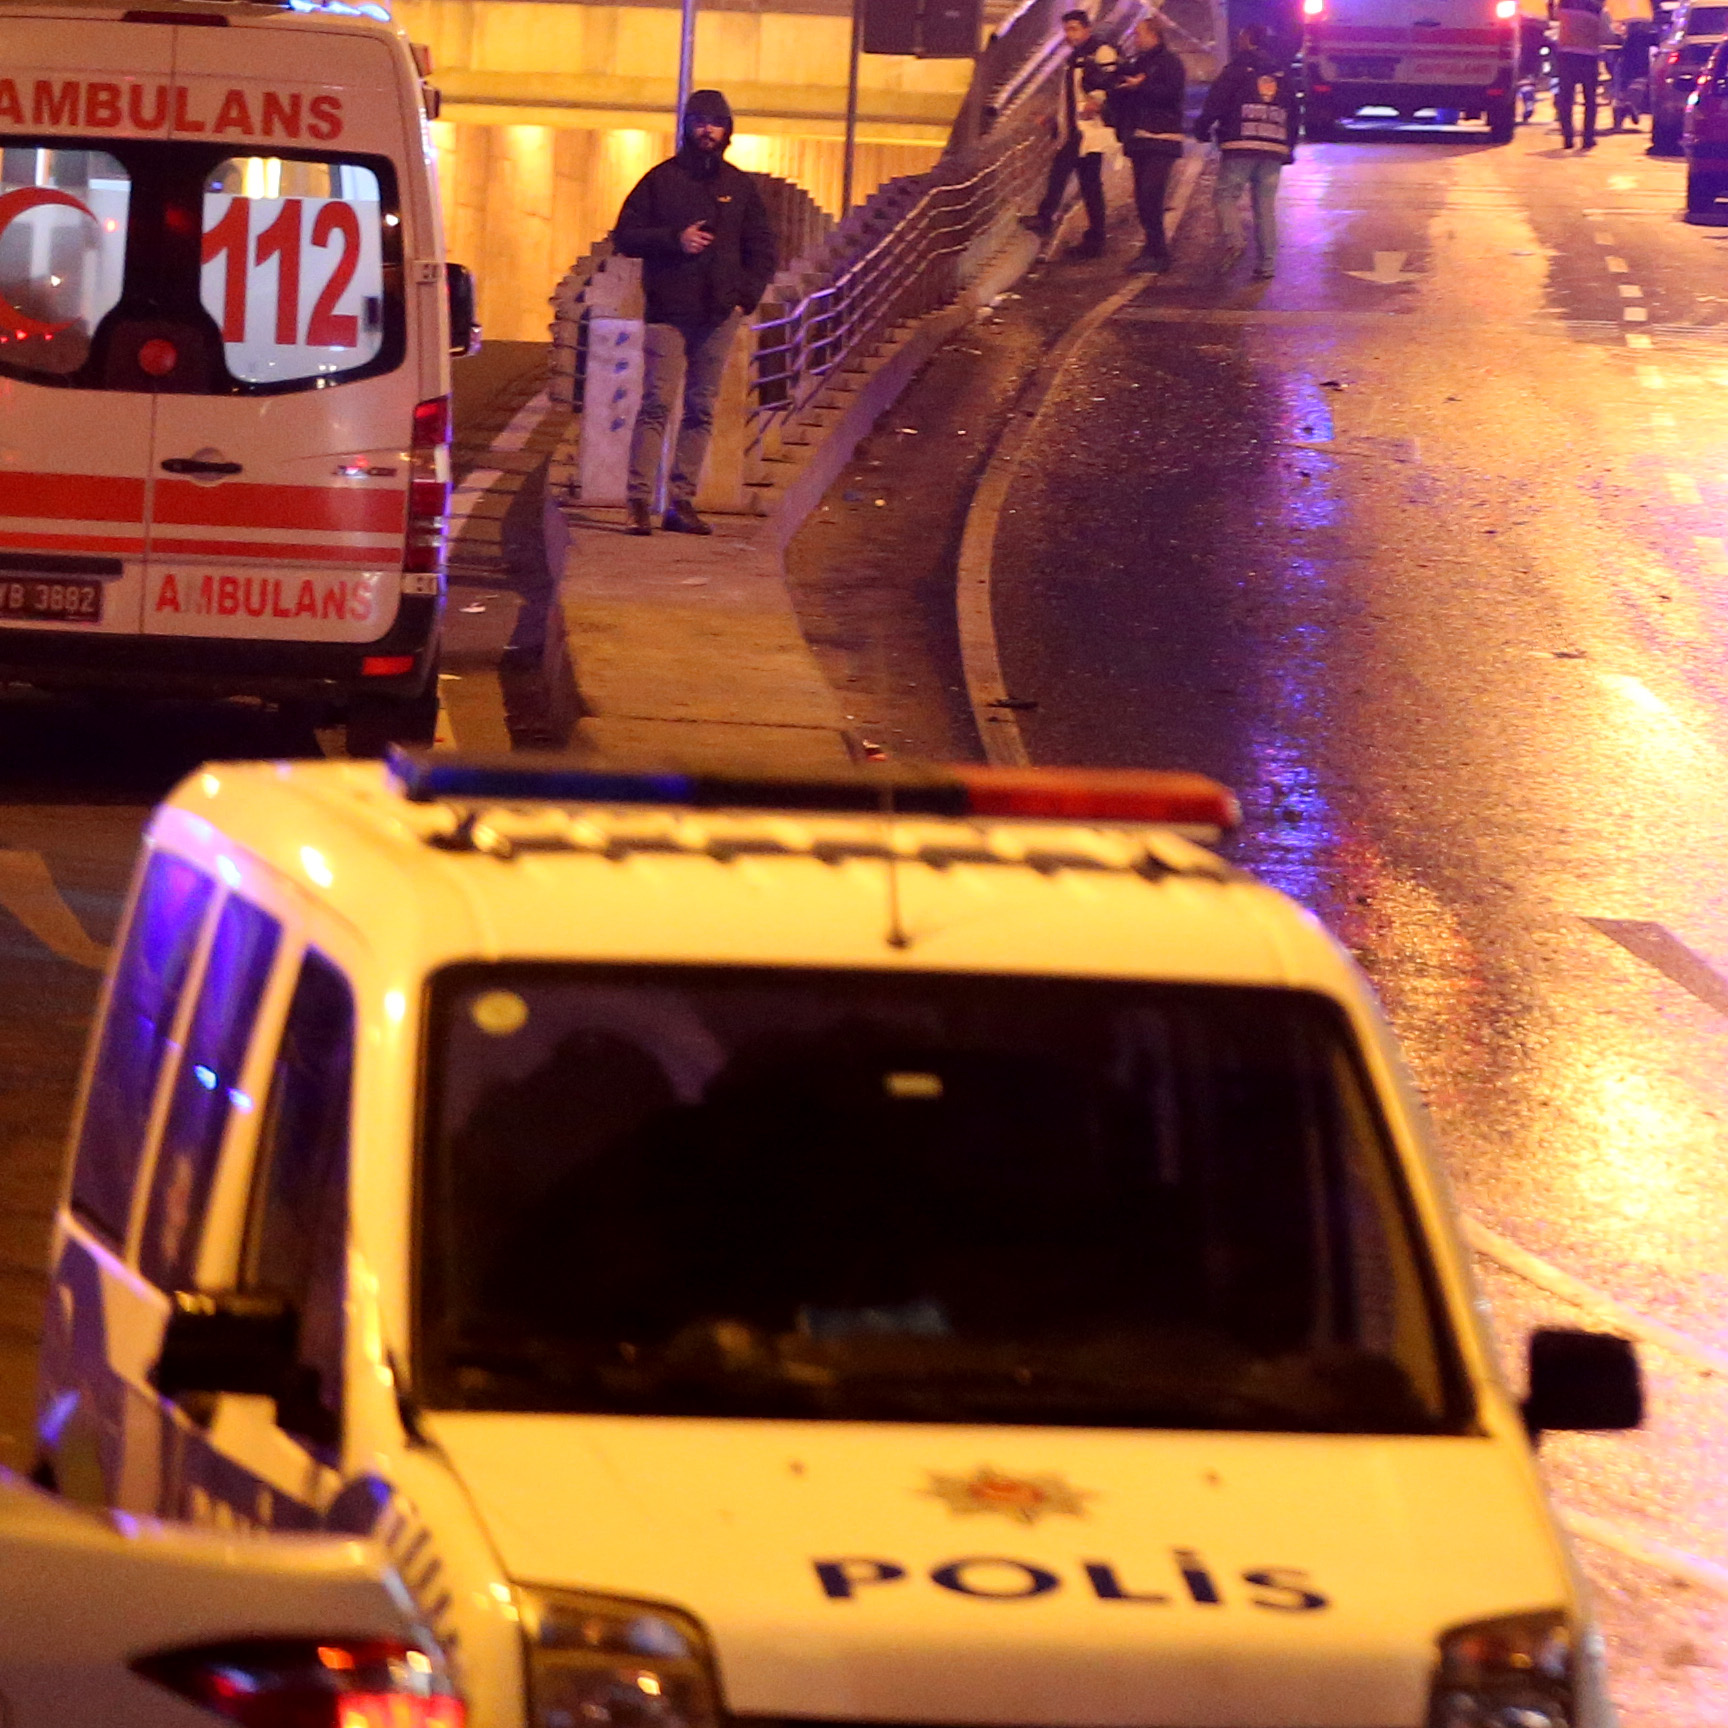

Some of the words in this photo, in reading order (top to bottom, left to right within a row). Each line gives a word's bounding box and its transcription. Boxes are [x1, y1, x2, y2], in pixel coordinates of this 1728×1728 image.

[0, 78, 344, 141] AMBULANS
[201, 197, 361, 348] 112
[155, 573, 377, 622] AMBULANS
[810, 1546, 1331, 1616] POLİS
